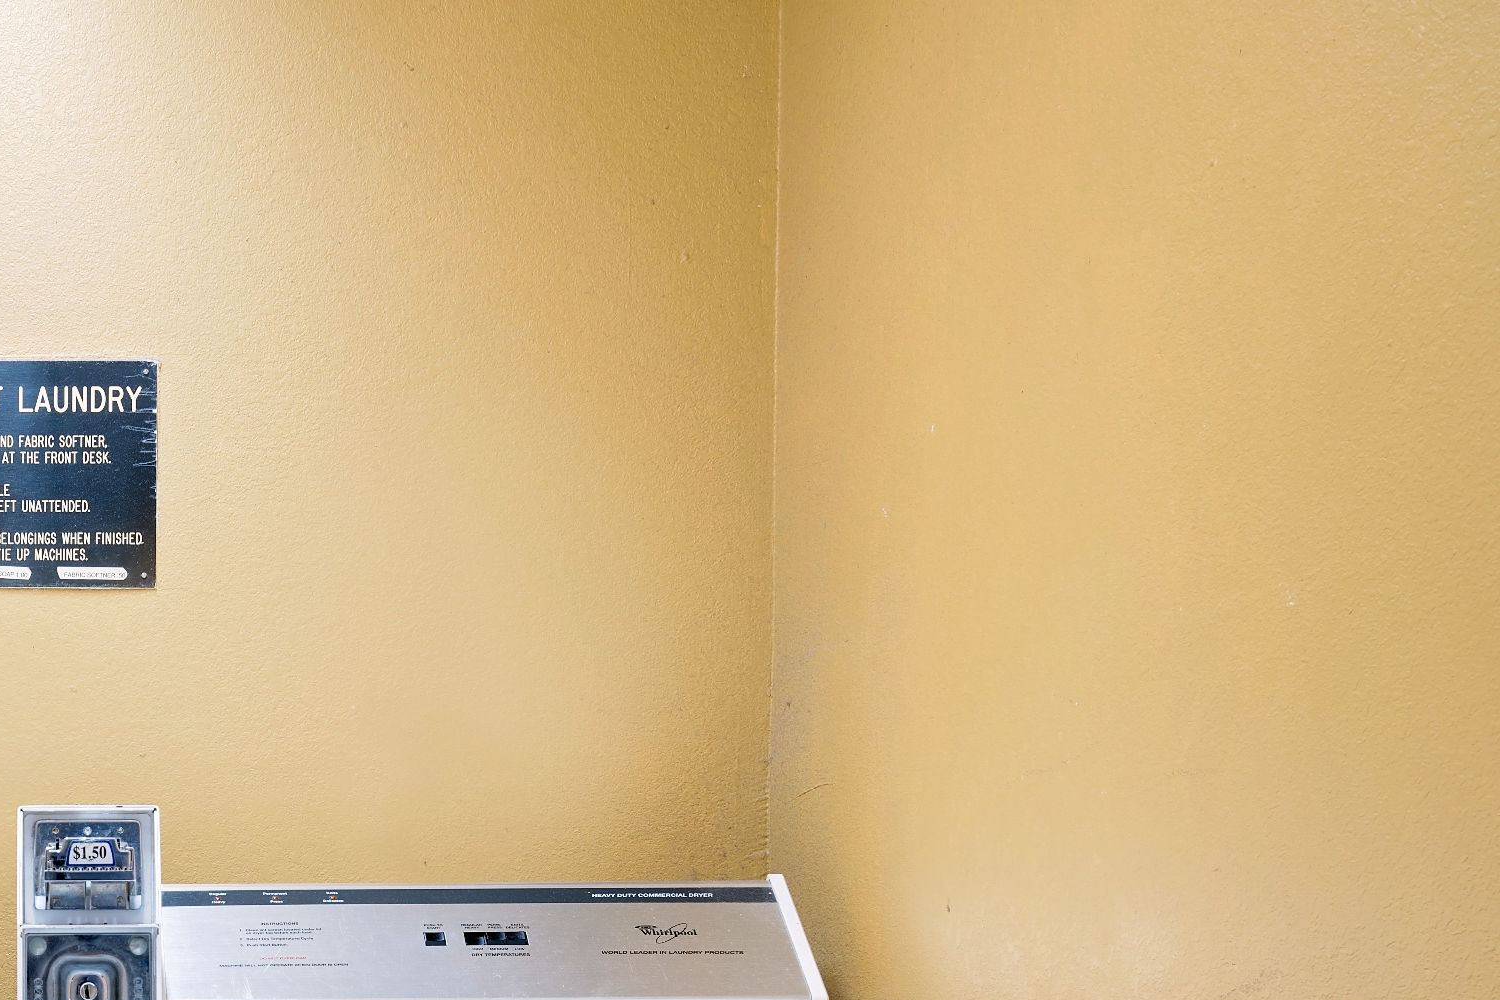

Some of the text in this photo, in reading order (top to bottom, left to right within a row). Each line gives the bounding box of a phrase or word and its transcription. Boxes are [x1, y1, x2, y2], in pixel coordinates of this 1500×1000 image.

[18, 386, 142, 413] LAUNDRY
[18, 435, 54, 448] FABRIC
[59, 435, 108, 448] SOFTNER,
[2, 451, 15, 464] AT
[20, 451, 40, 464] THE
[44, 451, 78, 464] FRONT
[82, 451, 111, 464] DESK.
[21, 500, 91, 512] UNATTENDED.
[61, 532, 90, 545] WHEN
[95, 532, 144, 545] FINISHED.
[16, 548, 30, 561] UP
[34, 548, 88, 561] MACHINES.
[73, 845, 107, 861] $1.50
[640, 927, 698, 938] Whirlpool
